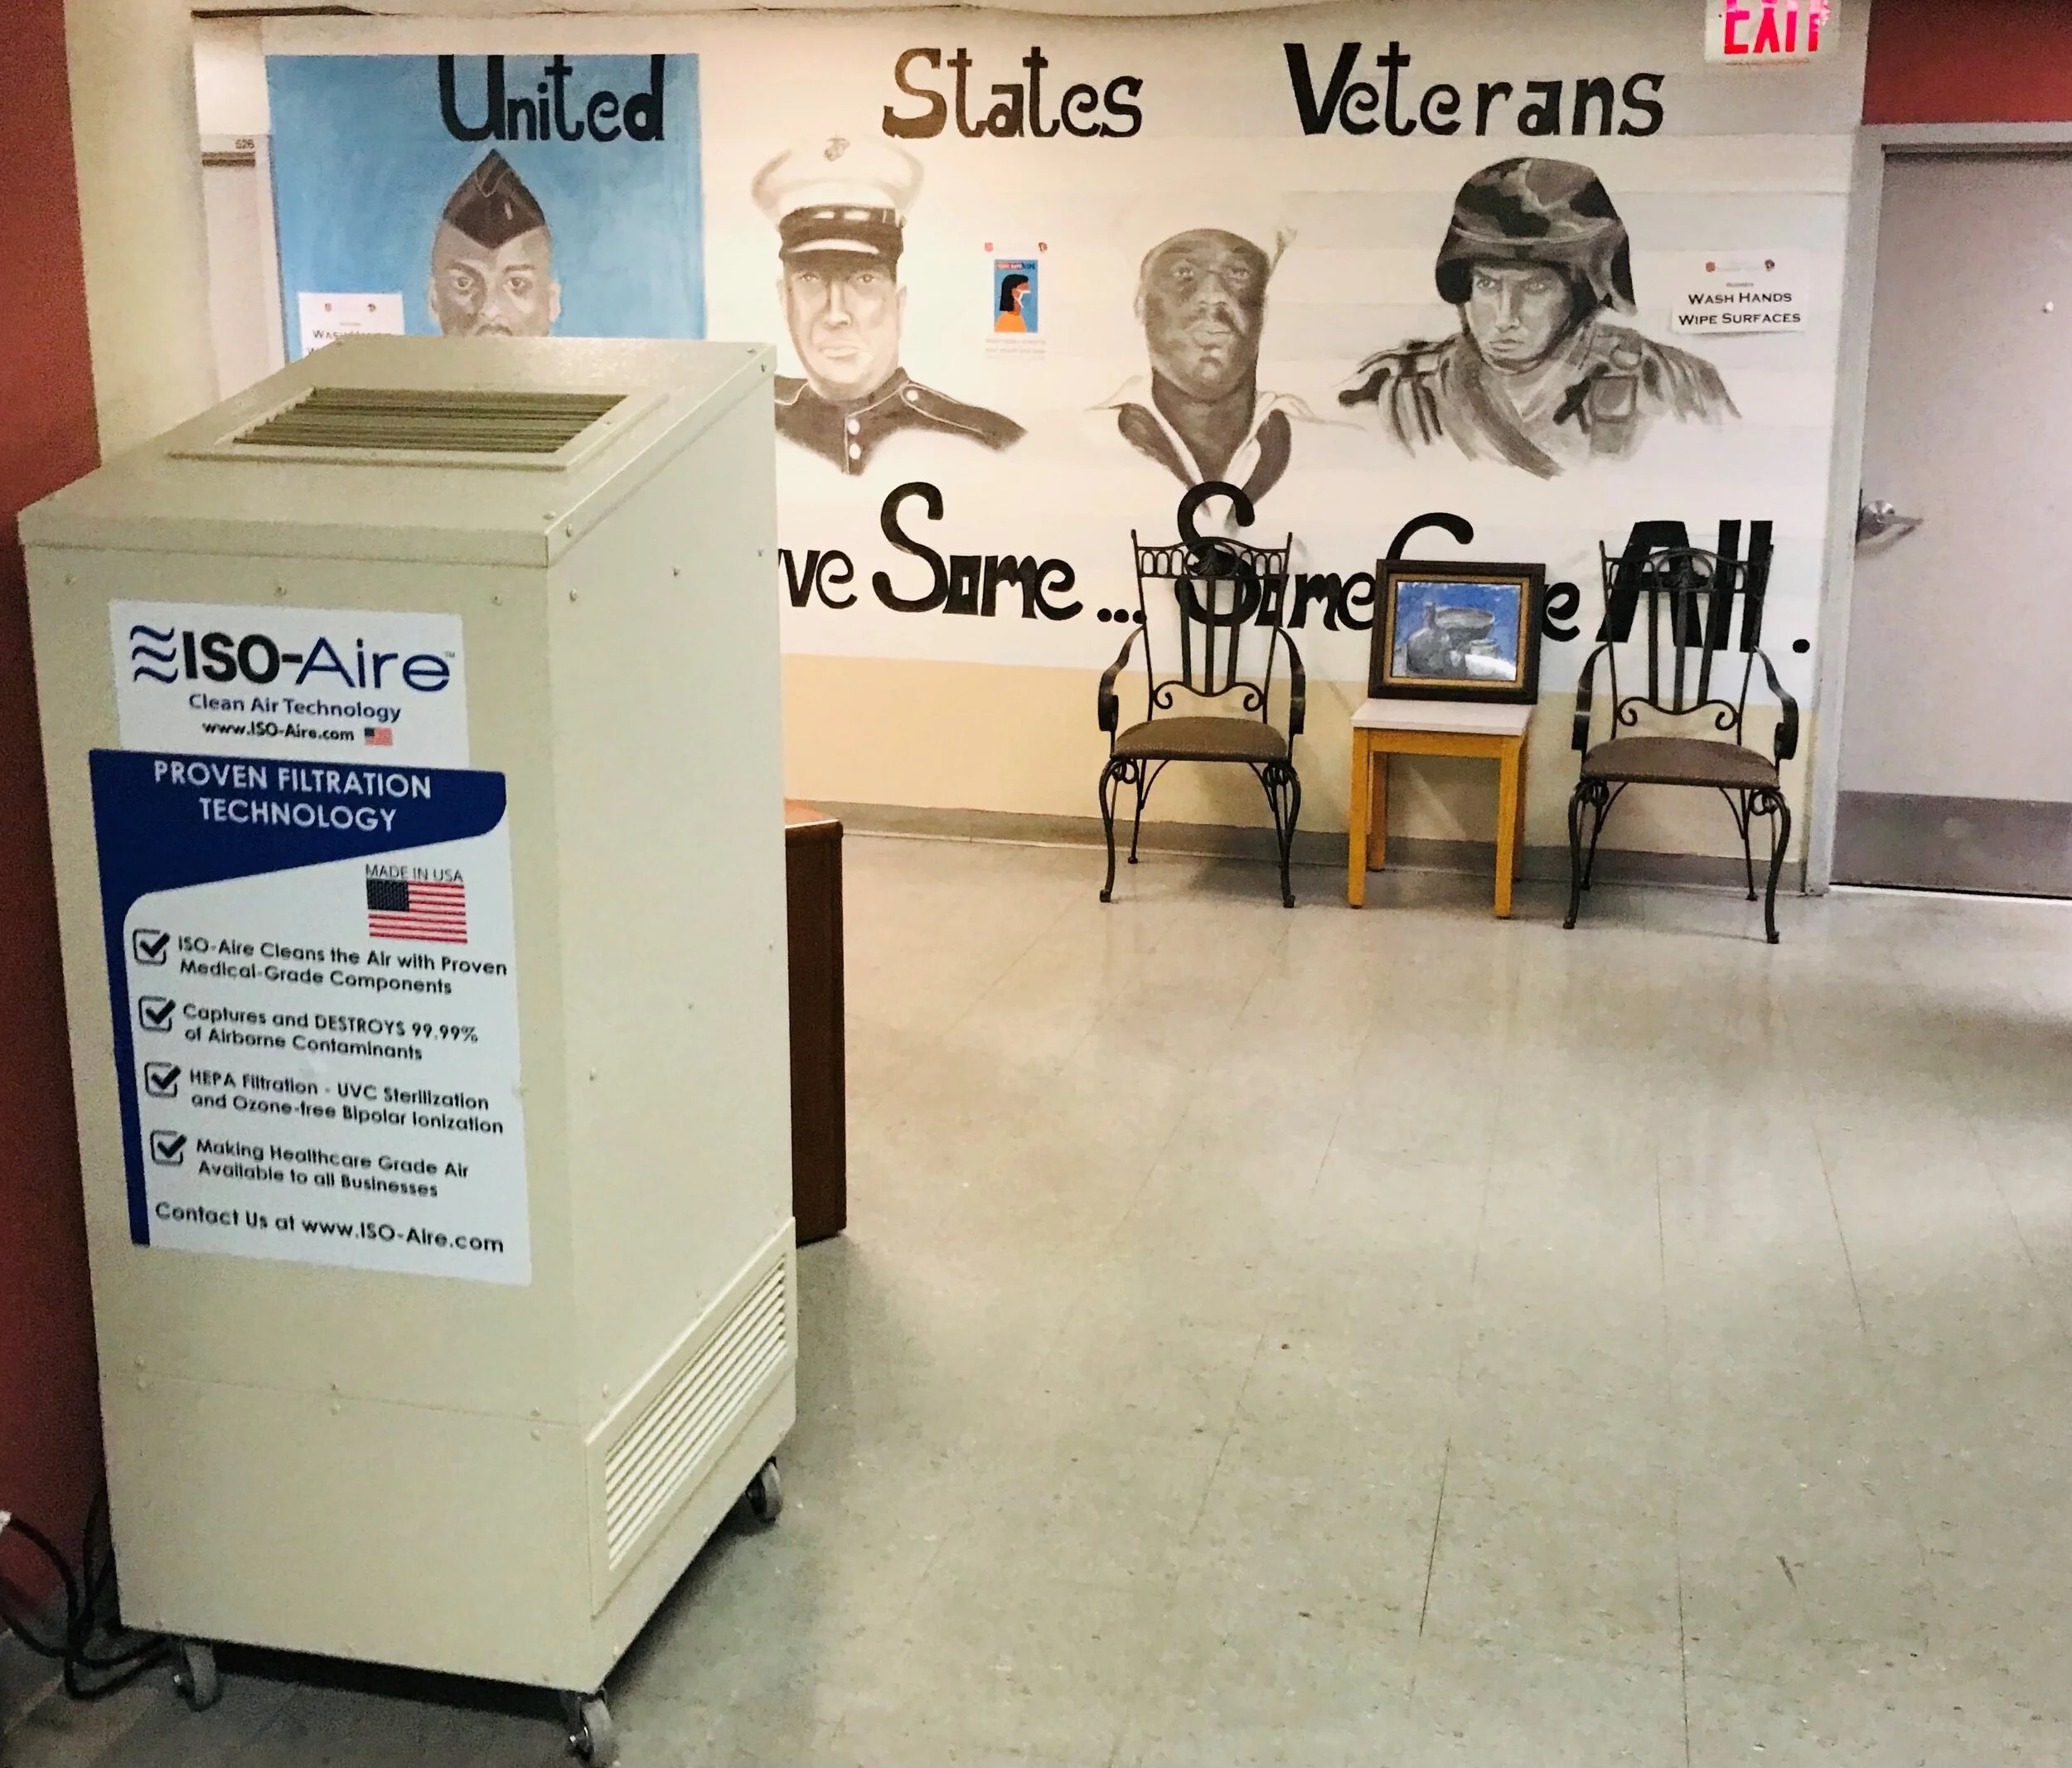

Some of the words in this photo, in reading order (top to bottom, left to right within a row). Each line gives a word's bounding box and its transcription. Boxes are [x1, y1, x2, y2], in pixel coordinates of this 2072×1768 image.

[1725, 0, 1830, 54] EXIT
[438, 55, 666, 142] United
[883, 46, 1144, 138] States
[1284, 41, 1665, 136] Veterans
[1678, 314, 1717, 325] WIPE
[1721, 312, 1802, 323] SURFACES
[1688, 293, 1735, 304] WASH
[1739, 293, 1793, 303] HANDS
[778, 548, 858, 609] ve
[1174, 481, 1376, 632] Some
[189, 693, 245, 713] Clean
[250, 695, 278, 714] Air
[283, 698, 402, 724] Technology
[201, 720, 355, 742] www.ISO-Aire.com
[154, 760, 267, 790] PROVEN
[278, 767, 431, 800] FILTRATION
[199, 797, 396, 833] TECHNOLOGY
[366, 864, 408, 879] MADE
[413, 867, 429, 880] IN
[433, 868, 464, 882] USA
[178, 936, 254, 957] ISO-Aire
[260, 942, 325, 962] Cleans
[331, 947, 361, 966] the
[367, 949, 392, 967] Air
[398, 952, 435, 971] with
[441, 956, 507, 976] Proven
[180, 958, 324, 985] Medical-Grade
[331, 970, 453, 995] Components
[183, 1003, 267, 1026] Captures
[272, 1009, 308, 1029] and
[315, 1014, 405, 1038] DESTROYS
[411, 1022, 479, 1044] 99.99%
[185, 1026, 202, 1042] of
[208, 1027, 286, 1049] Airborne
[293, 1034, 423, 1061] Contaminants
[189, 1069, 236, 1087] HEPA
[242, 1073, 318, 1095] Filtration
[337, 1082, 378, 1101] UVC
[384, 1086, 490, 1112] Sterilization
[191, 1092, 227, 1109] and
[233, 1094, 336, 1119] Ozone-free
[342, 1104, 406, 1126] Bipolar
[413, 1110, 504, 1135] Ionization
[196, 1138, 264, 1162] Making
[269, 1144, 372, 1170] Healthcare
[378, 1154, 438, 1175] Grade
[444, 1160, 469, 1179] Air
[198, 1160, 284, 1183] Available
[290, 1167, 307, 1184] to
[313, 1168, 335, 1187] all
[341, 1175, 438, 1198] Businesses
[155, 1200, 239, 1226] Contact
[245, 1211, 268, 1229] Us
[275, 1213, 295, 1232] at
[302, 1218, 505, 1253] www.ISO-Aire.com
